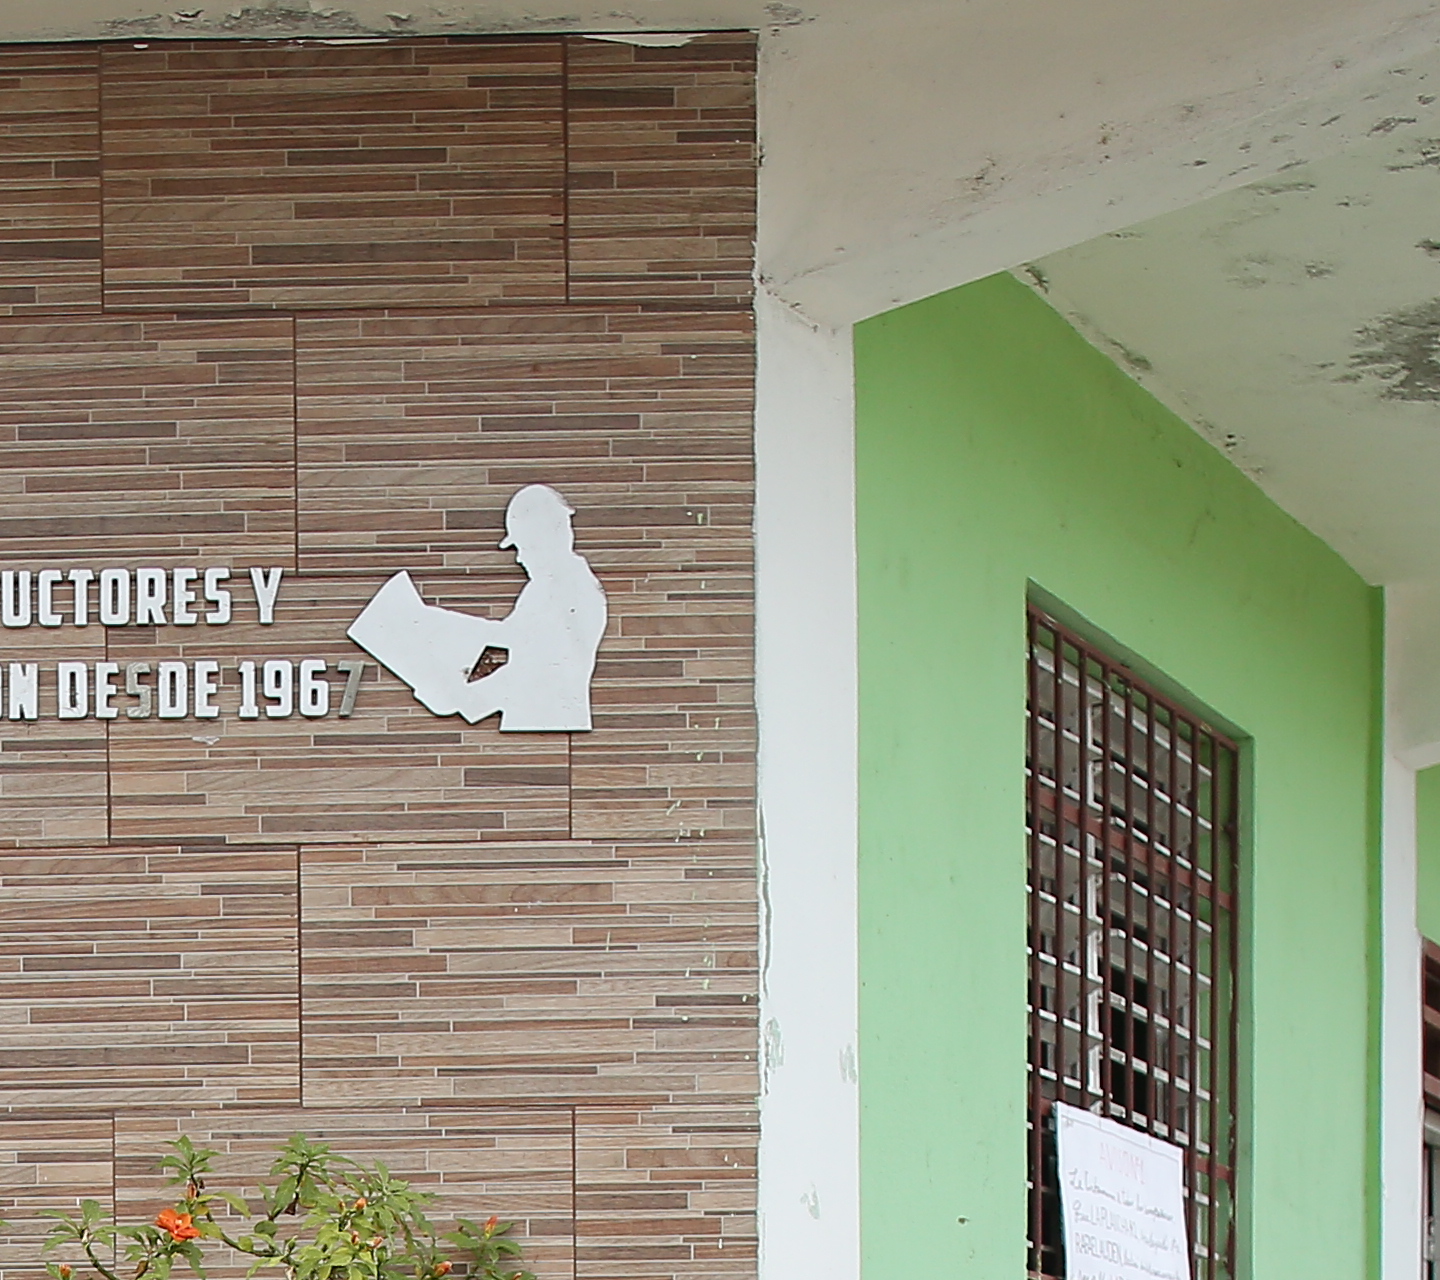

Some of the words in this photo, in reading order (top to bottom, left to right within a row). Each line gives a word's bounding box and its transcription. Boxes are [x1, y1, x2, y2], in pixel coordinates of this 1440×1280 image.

[249, 567, 283, 625] Y
[58, 661, 220, 720] DESDE
[237, 659, 365, 719] 1967
